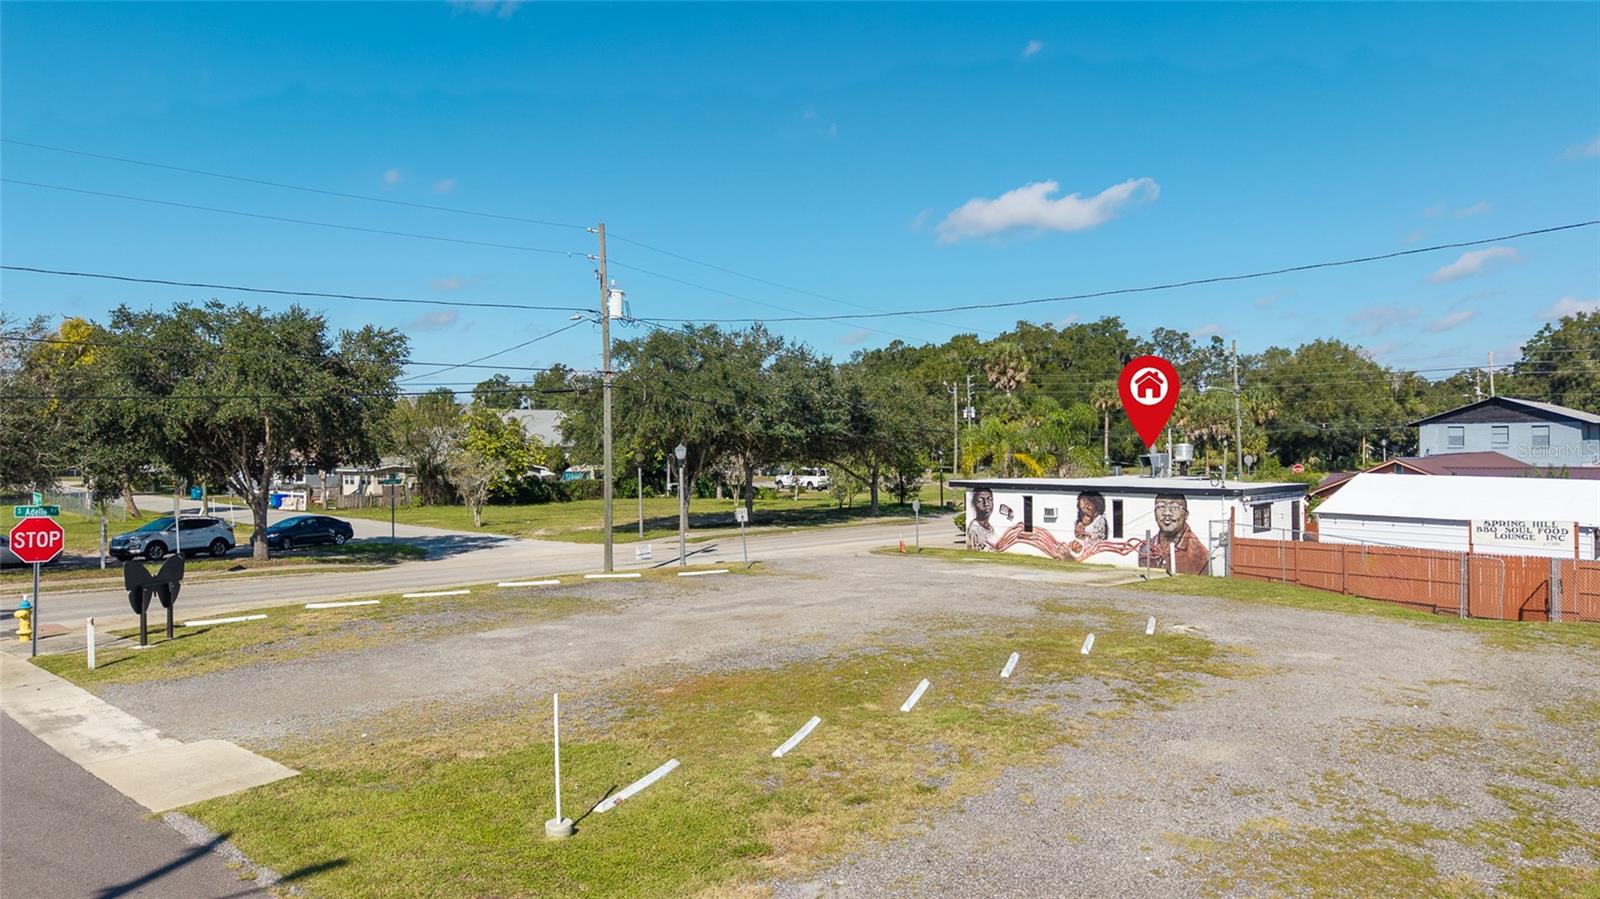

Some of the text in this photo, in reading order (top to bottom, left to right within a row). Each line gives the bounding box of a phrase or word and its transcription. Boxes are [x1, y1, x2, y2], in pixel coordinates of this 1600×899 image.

[1483, 520, 1559, 529] SPRING HILL
[1537, 527, 1569, 535] FOOD
[14, 531, 60, 549] STOP
[1494, 532, 1565, 542] LOUNGE INC
